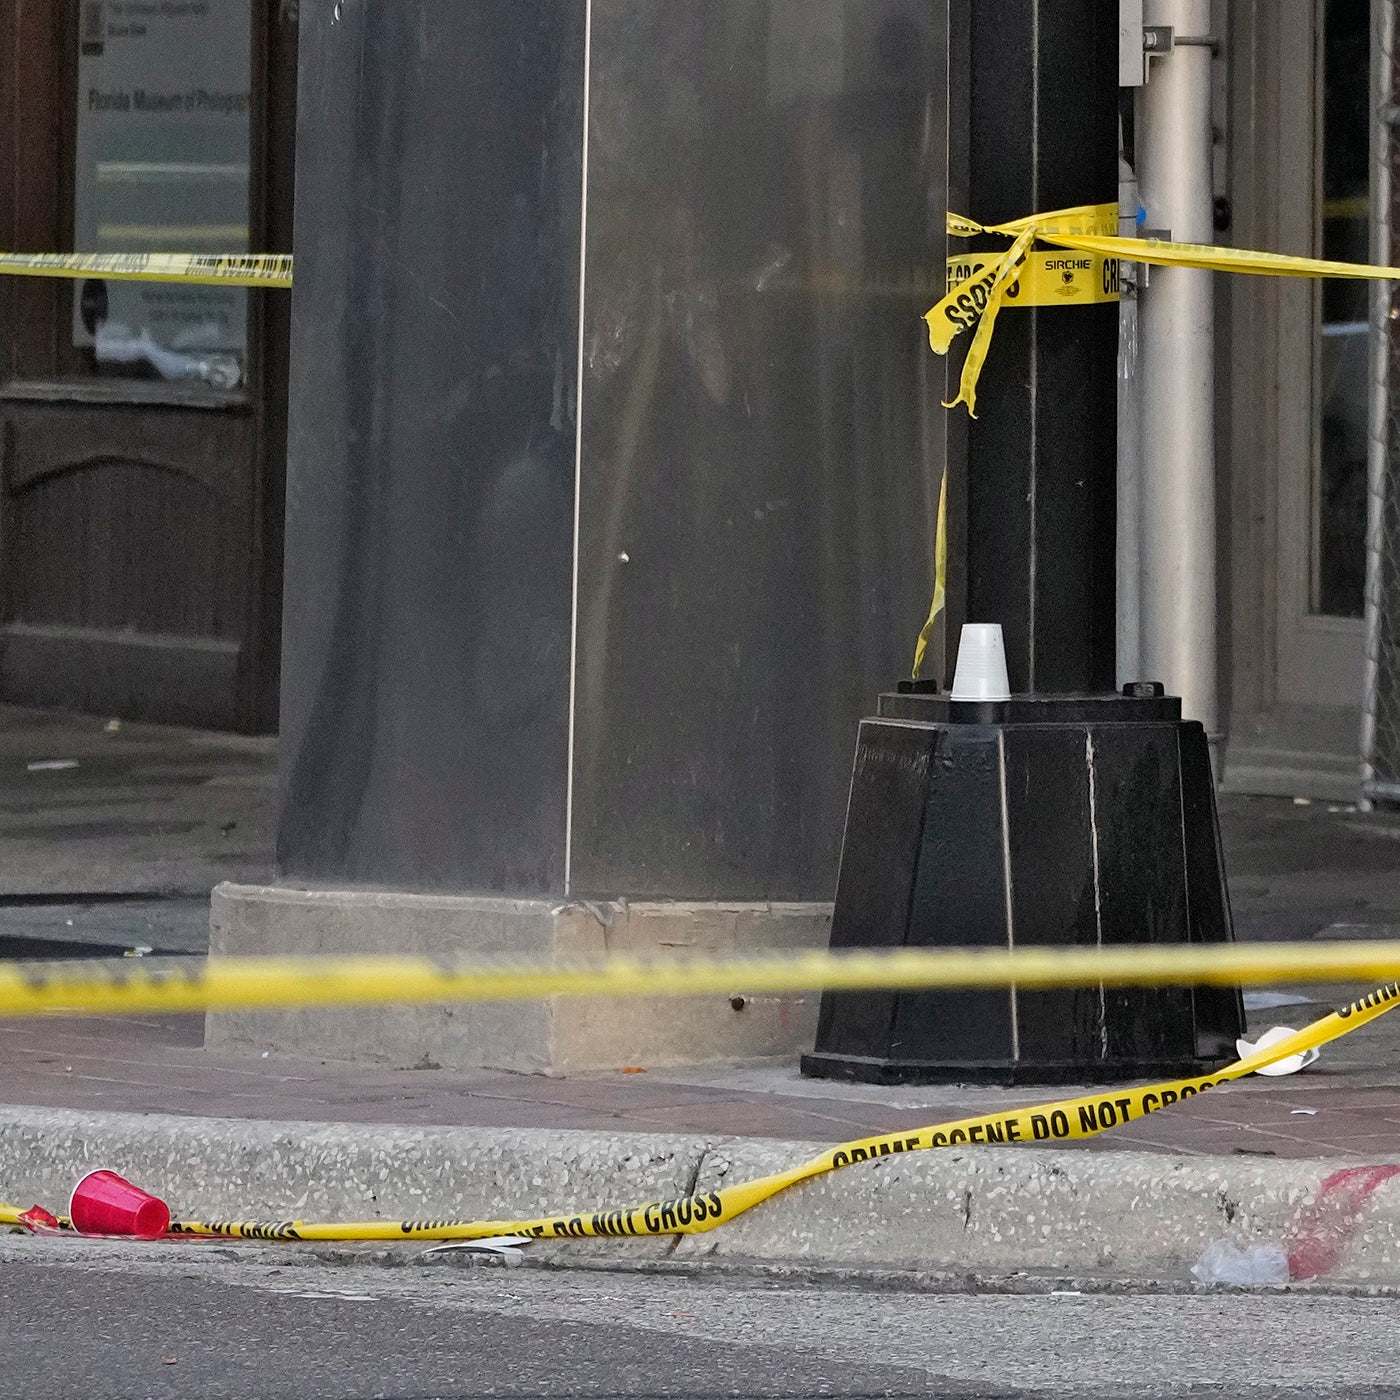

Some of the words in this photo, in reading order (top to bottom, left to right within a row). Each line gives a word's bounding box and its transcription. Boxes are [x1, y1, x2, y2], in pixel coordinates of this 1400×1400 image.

[1045, 260, 1093, 271] SIRCHIE
[1031, 1109, 1070, 1141] DO
[1079, 1099, 1132, 1133] NOT
[591, 1207, 641, 1237] NOT
[643, 1191, 723, 1234] CROSS
